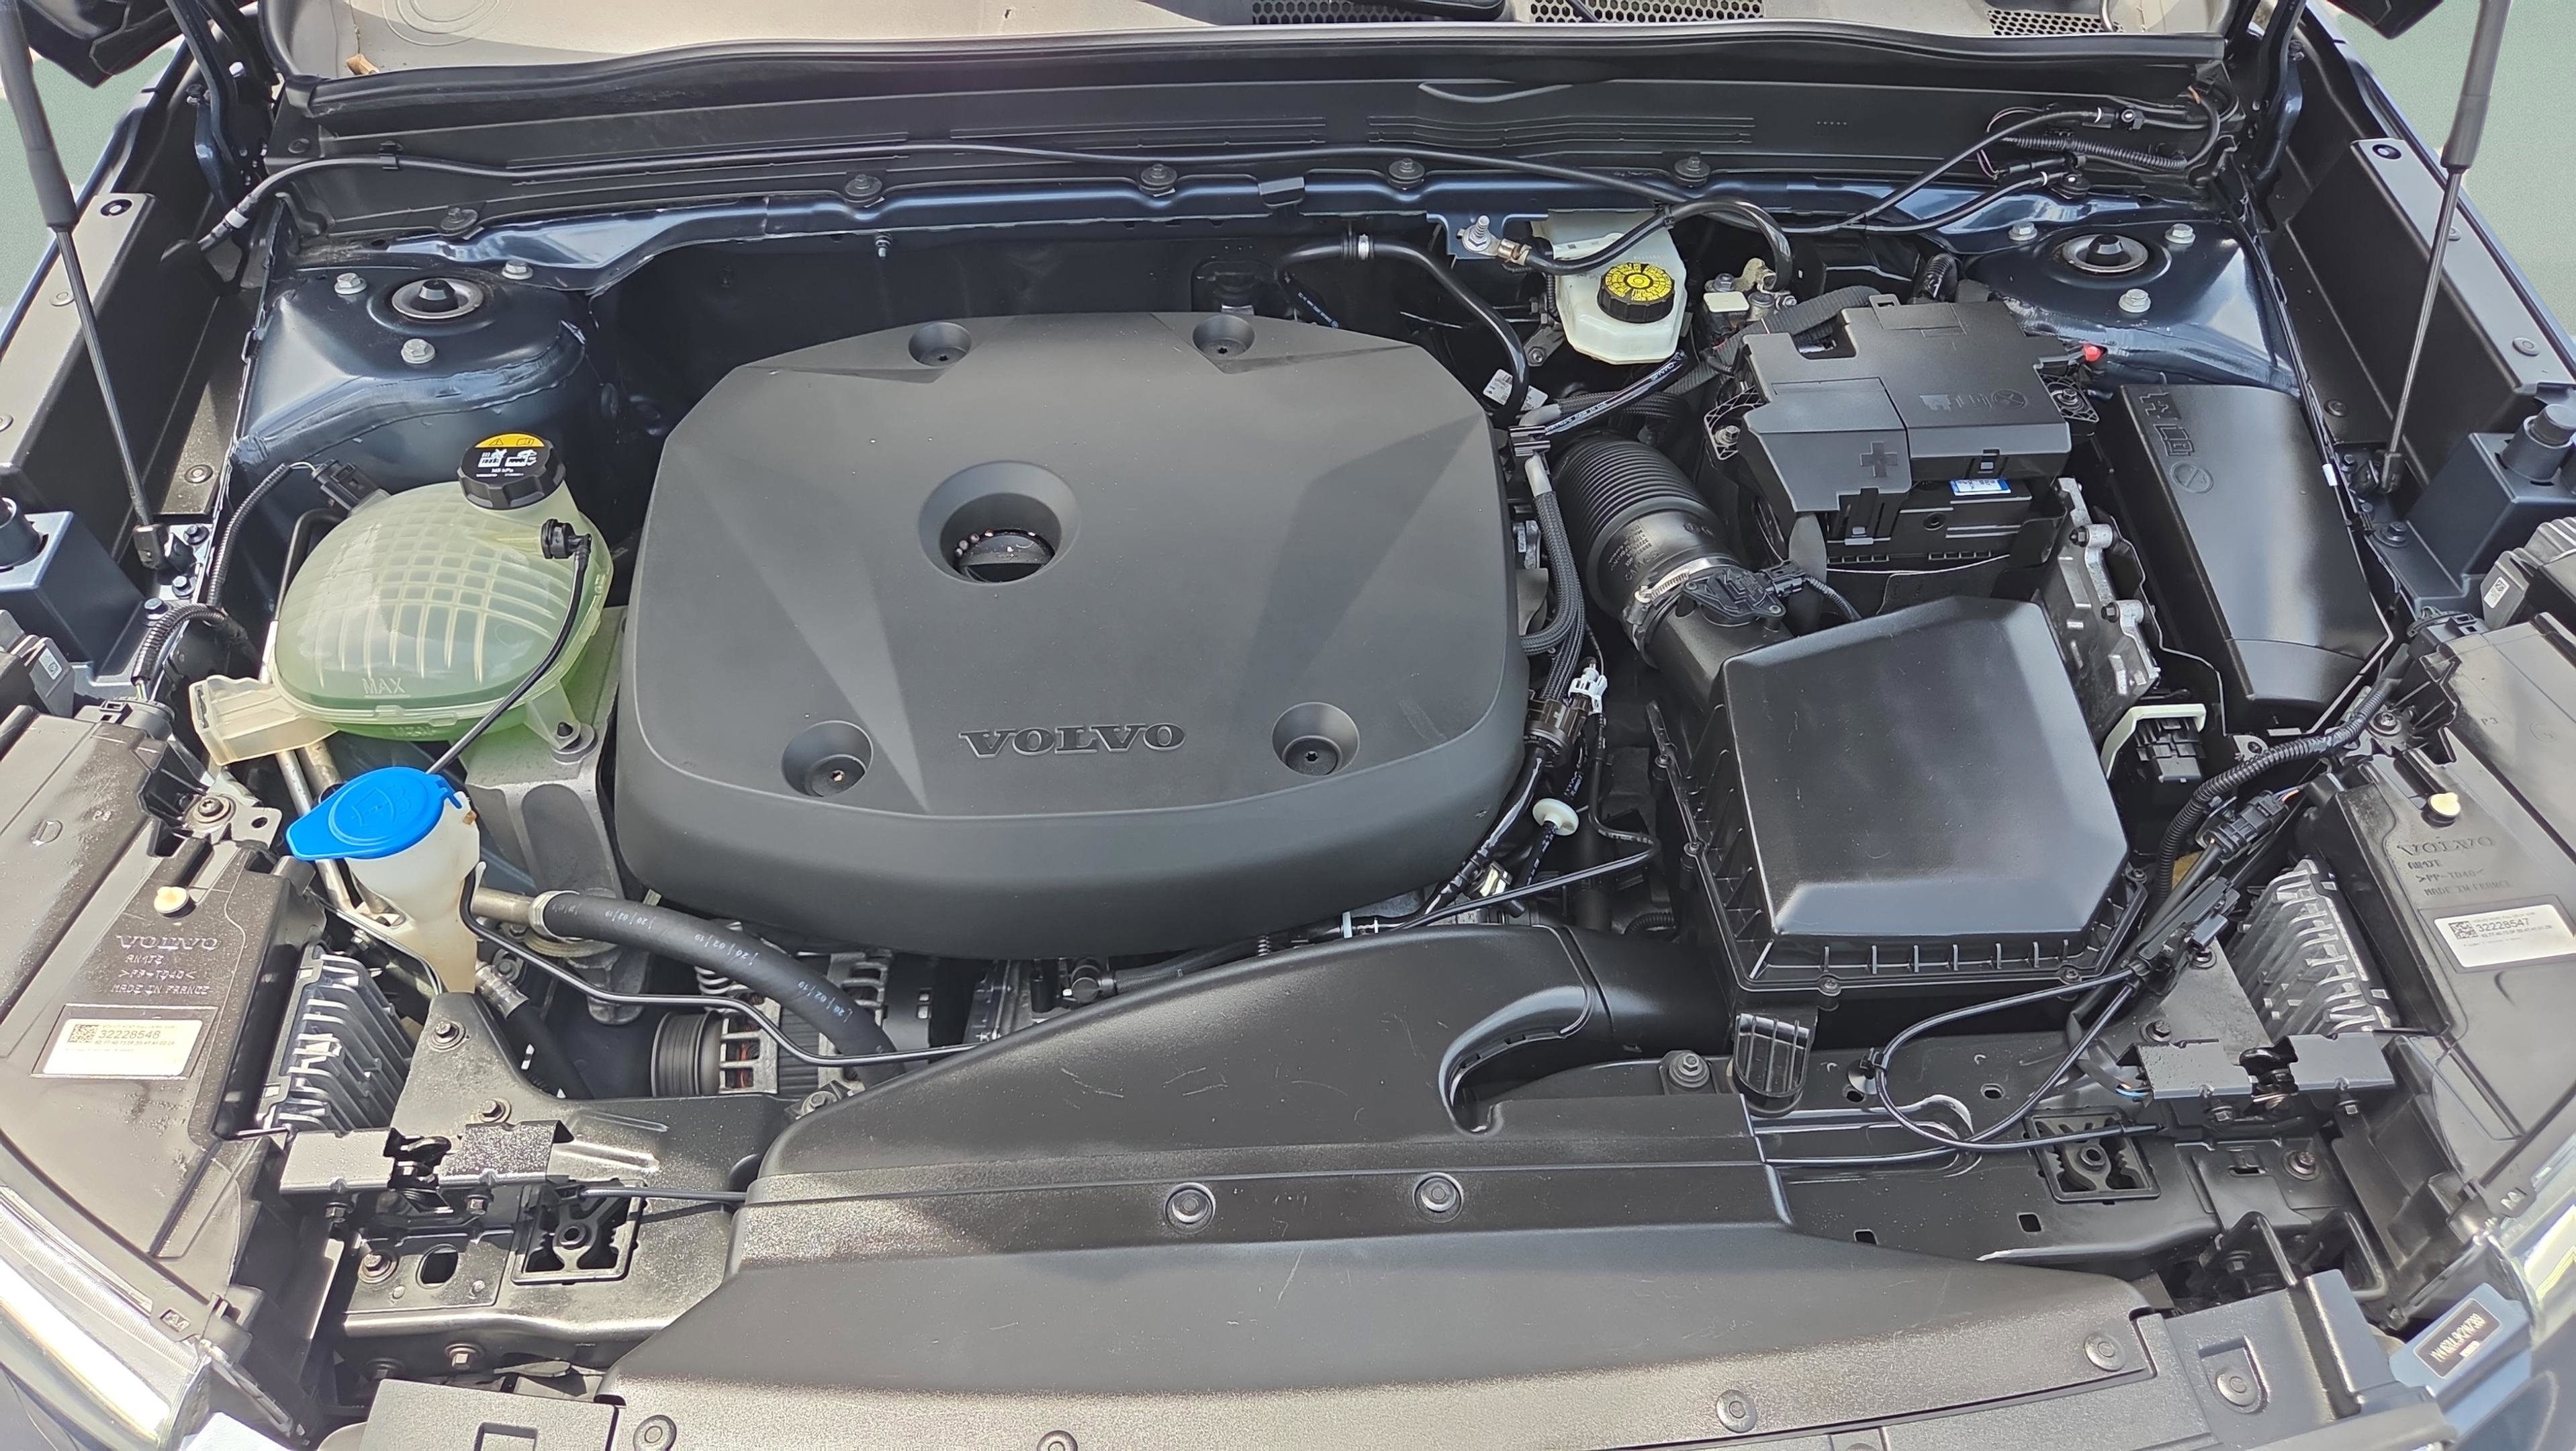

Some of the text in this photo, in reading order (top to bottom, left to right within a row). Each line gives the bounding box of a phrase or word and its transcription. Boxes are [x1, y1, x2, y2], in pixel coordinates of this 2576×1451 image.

[362, 677, 406, 694] MAX
[958, 723, 1186, 758] VOLVO
[2397, 836, 2493, 856] VOLVO
[2424, 887, 2451, 897] MADE
[2476, 918, 2530, 932] 32228547
[116, 935, 221, 951] VOLVO
[111, 983, 211, 996] MADE IN FRANCE
[98, 1030, 161, 1039] 32228548
